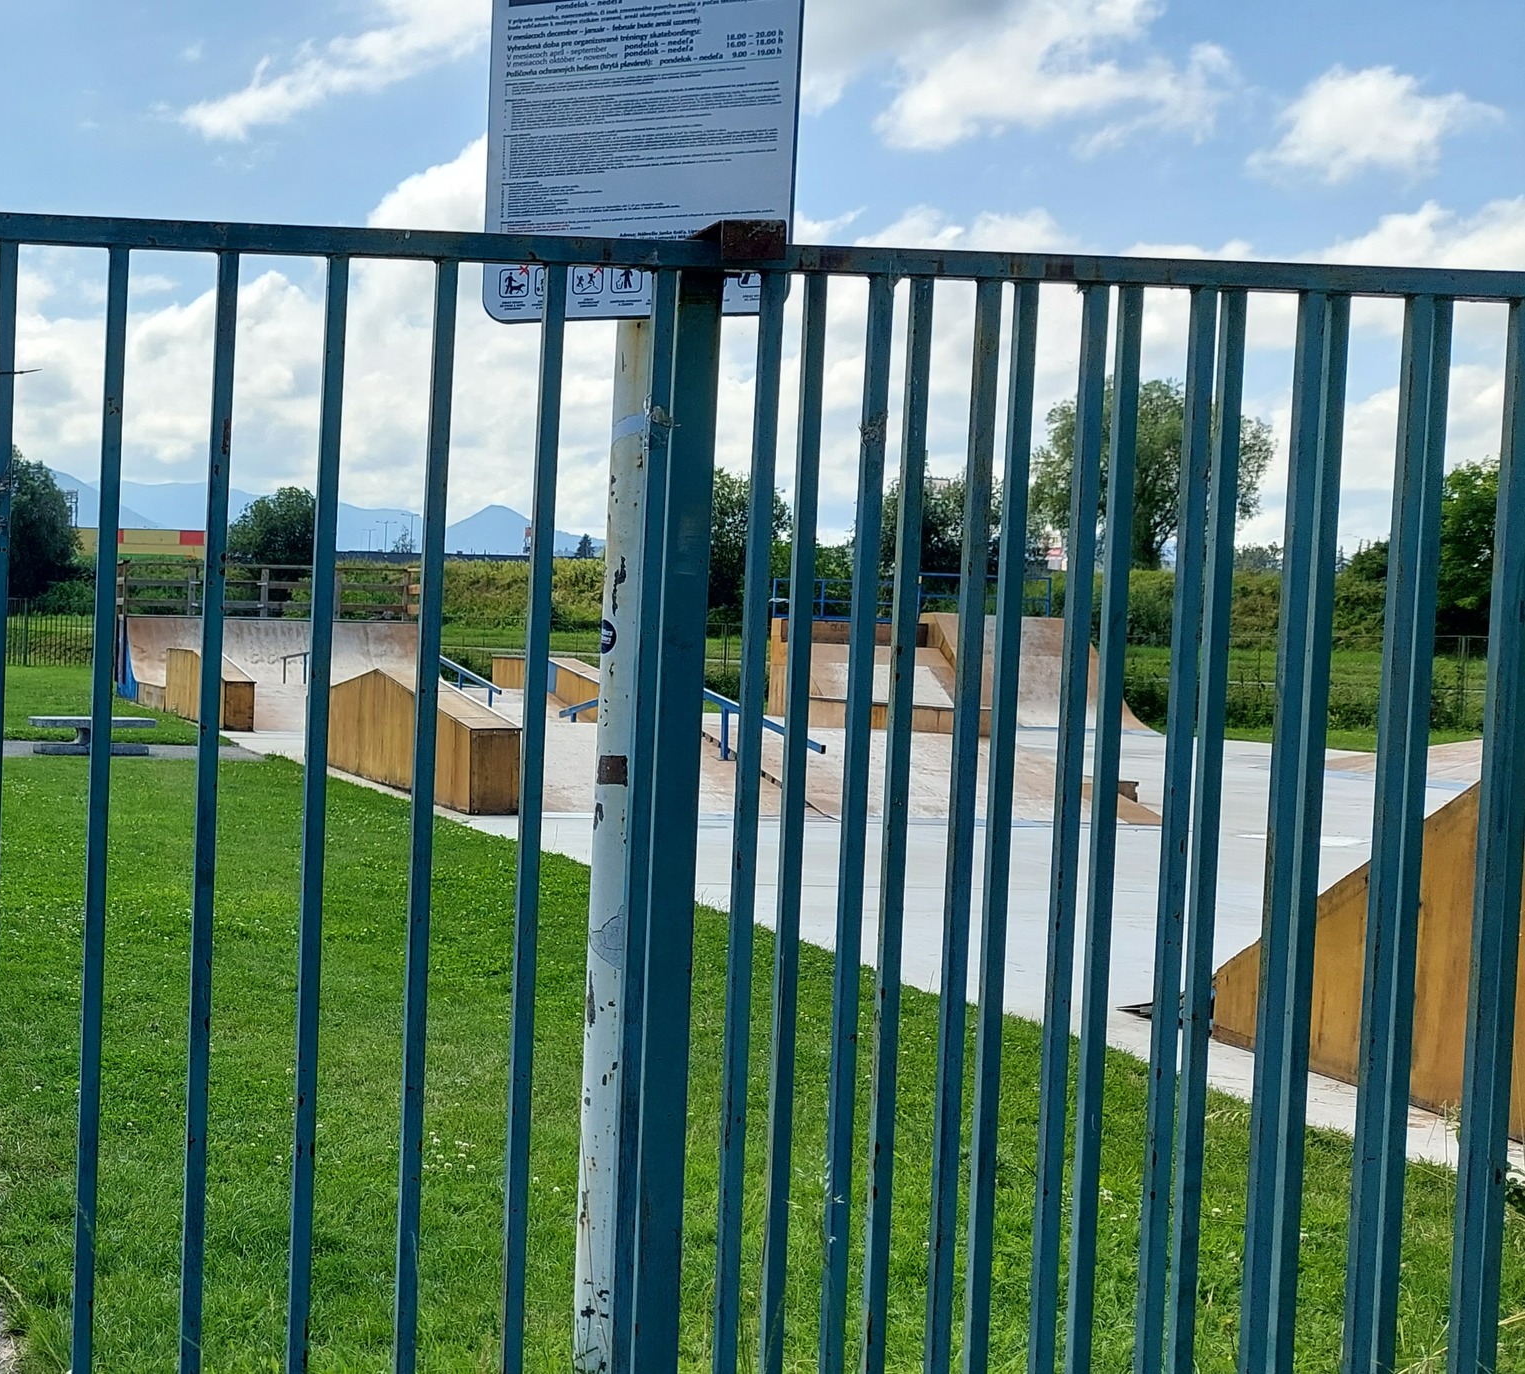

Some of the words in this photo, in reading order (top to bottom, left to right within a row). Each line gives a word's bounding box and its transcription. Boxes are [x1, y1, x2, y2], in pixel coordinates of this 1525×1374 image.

[555, 1, 588, 12] pondelok
[513, 51, 548, 60] mesiacoch
[571, 46, 607, 56] september
[624, 41, 658, 52] pondelok
[543, 41, 560, 49] doba
[561, 41, 572, 49] pre
[513, 58, 548, 67] mesiacoch
[583, 52, 618, 61] november
[624, 49, 658, 59] pondelok
[726, 41, 746, 49] 16.00
[659, 55, 691, 66] pondelok
[732, 50, 747, 58] 9.00
